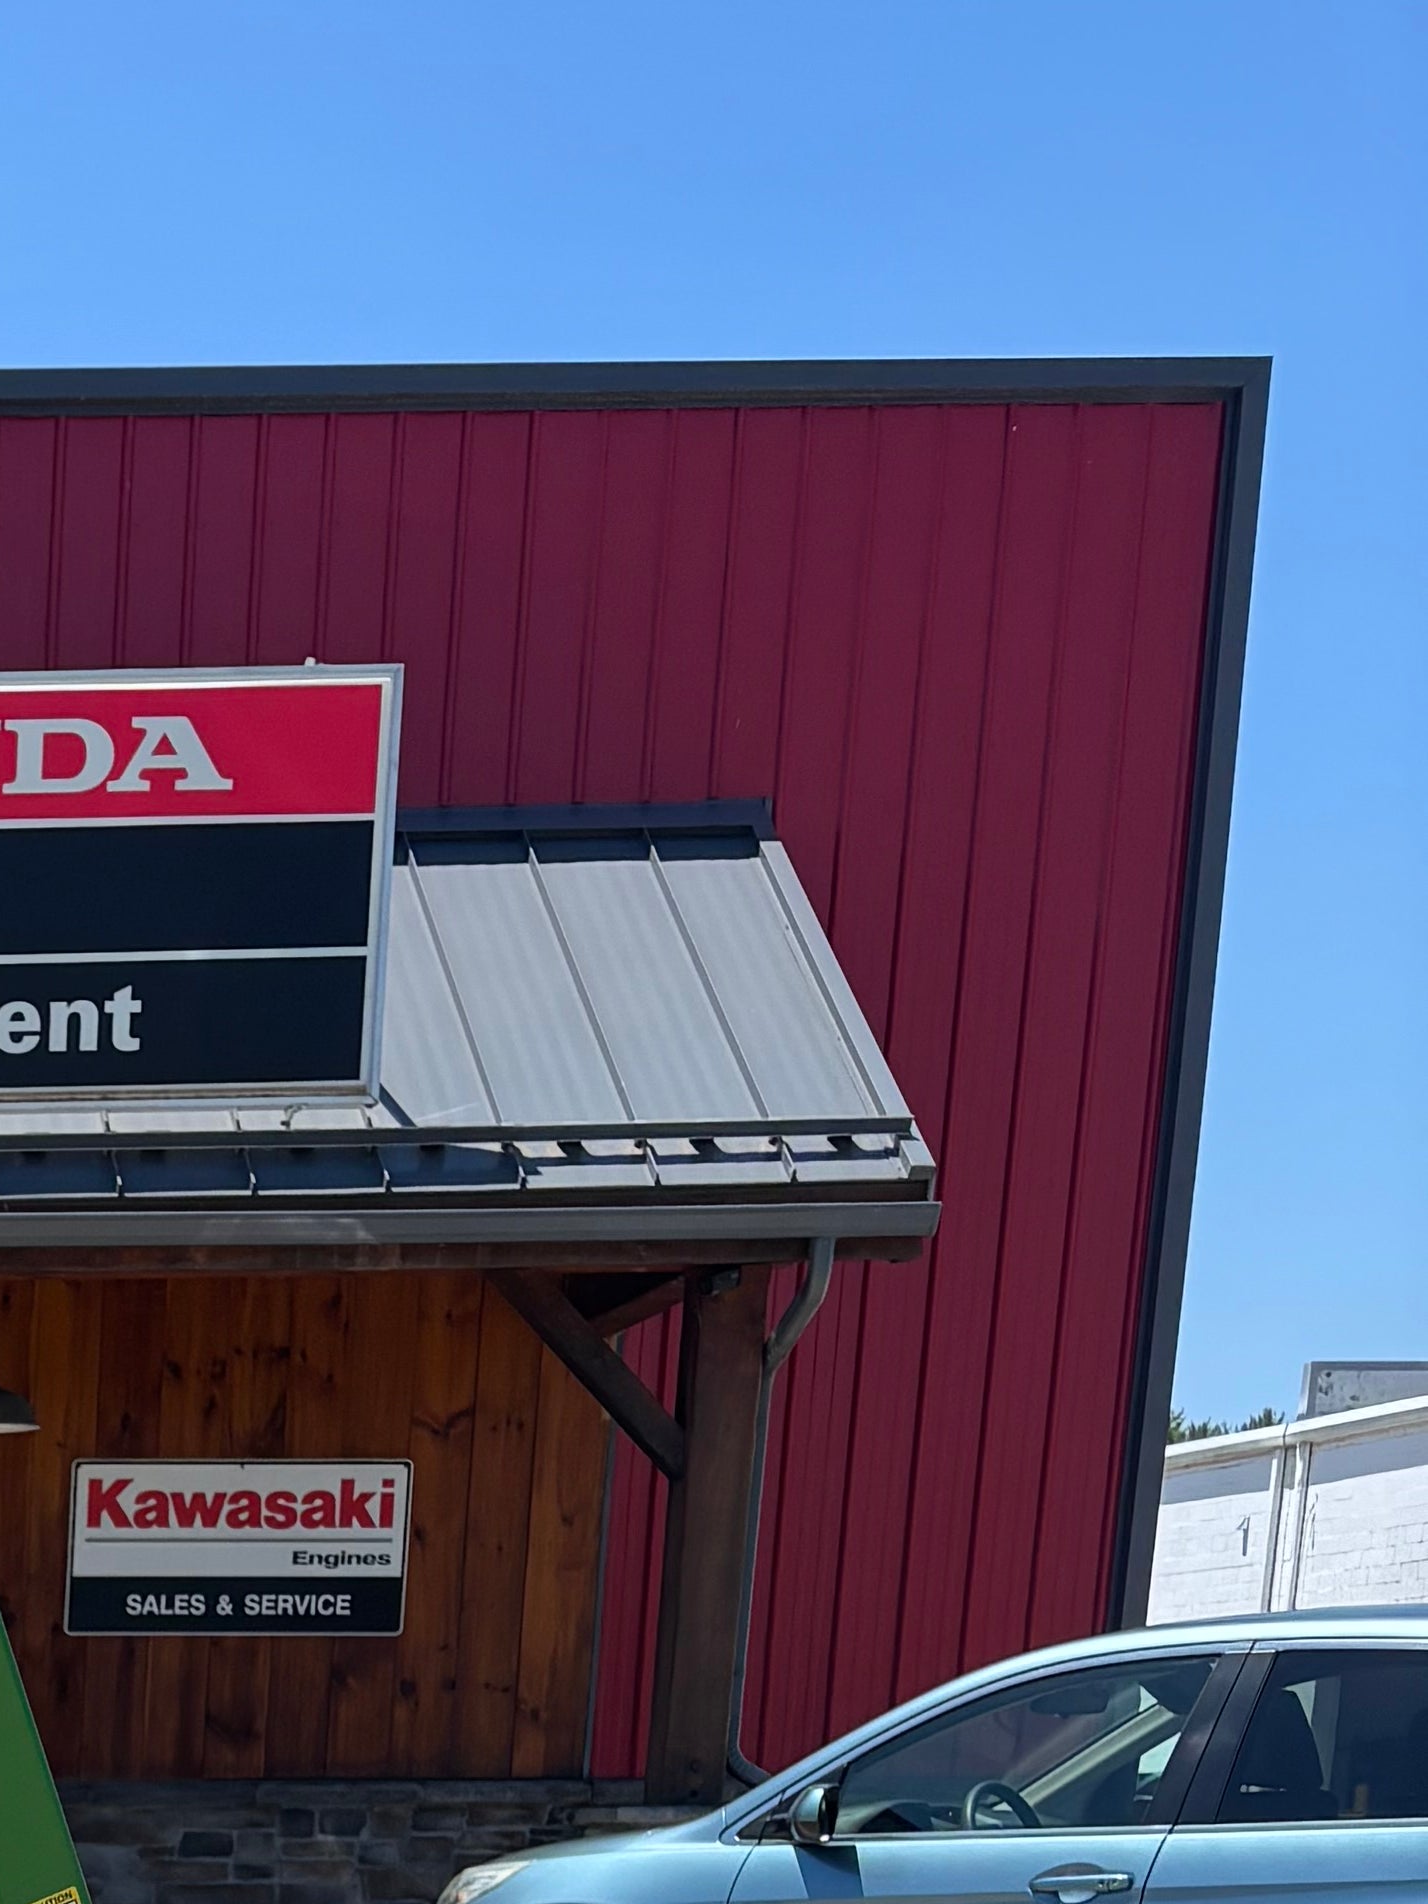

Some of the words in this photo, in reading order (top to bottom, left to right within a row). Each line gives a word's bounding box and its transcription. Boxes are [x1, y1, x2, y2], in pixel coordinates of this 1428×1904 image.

[85, 1477, 396, 1530] Kawasaki
[292, 1550, 392, 1569] Engines
[125, 1593, 206, 1616] SALES
[216, 1594, 234, 1616] &
[243, 1593, 352, 1616] SERVICE
